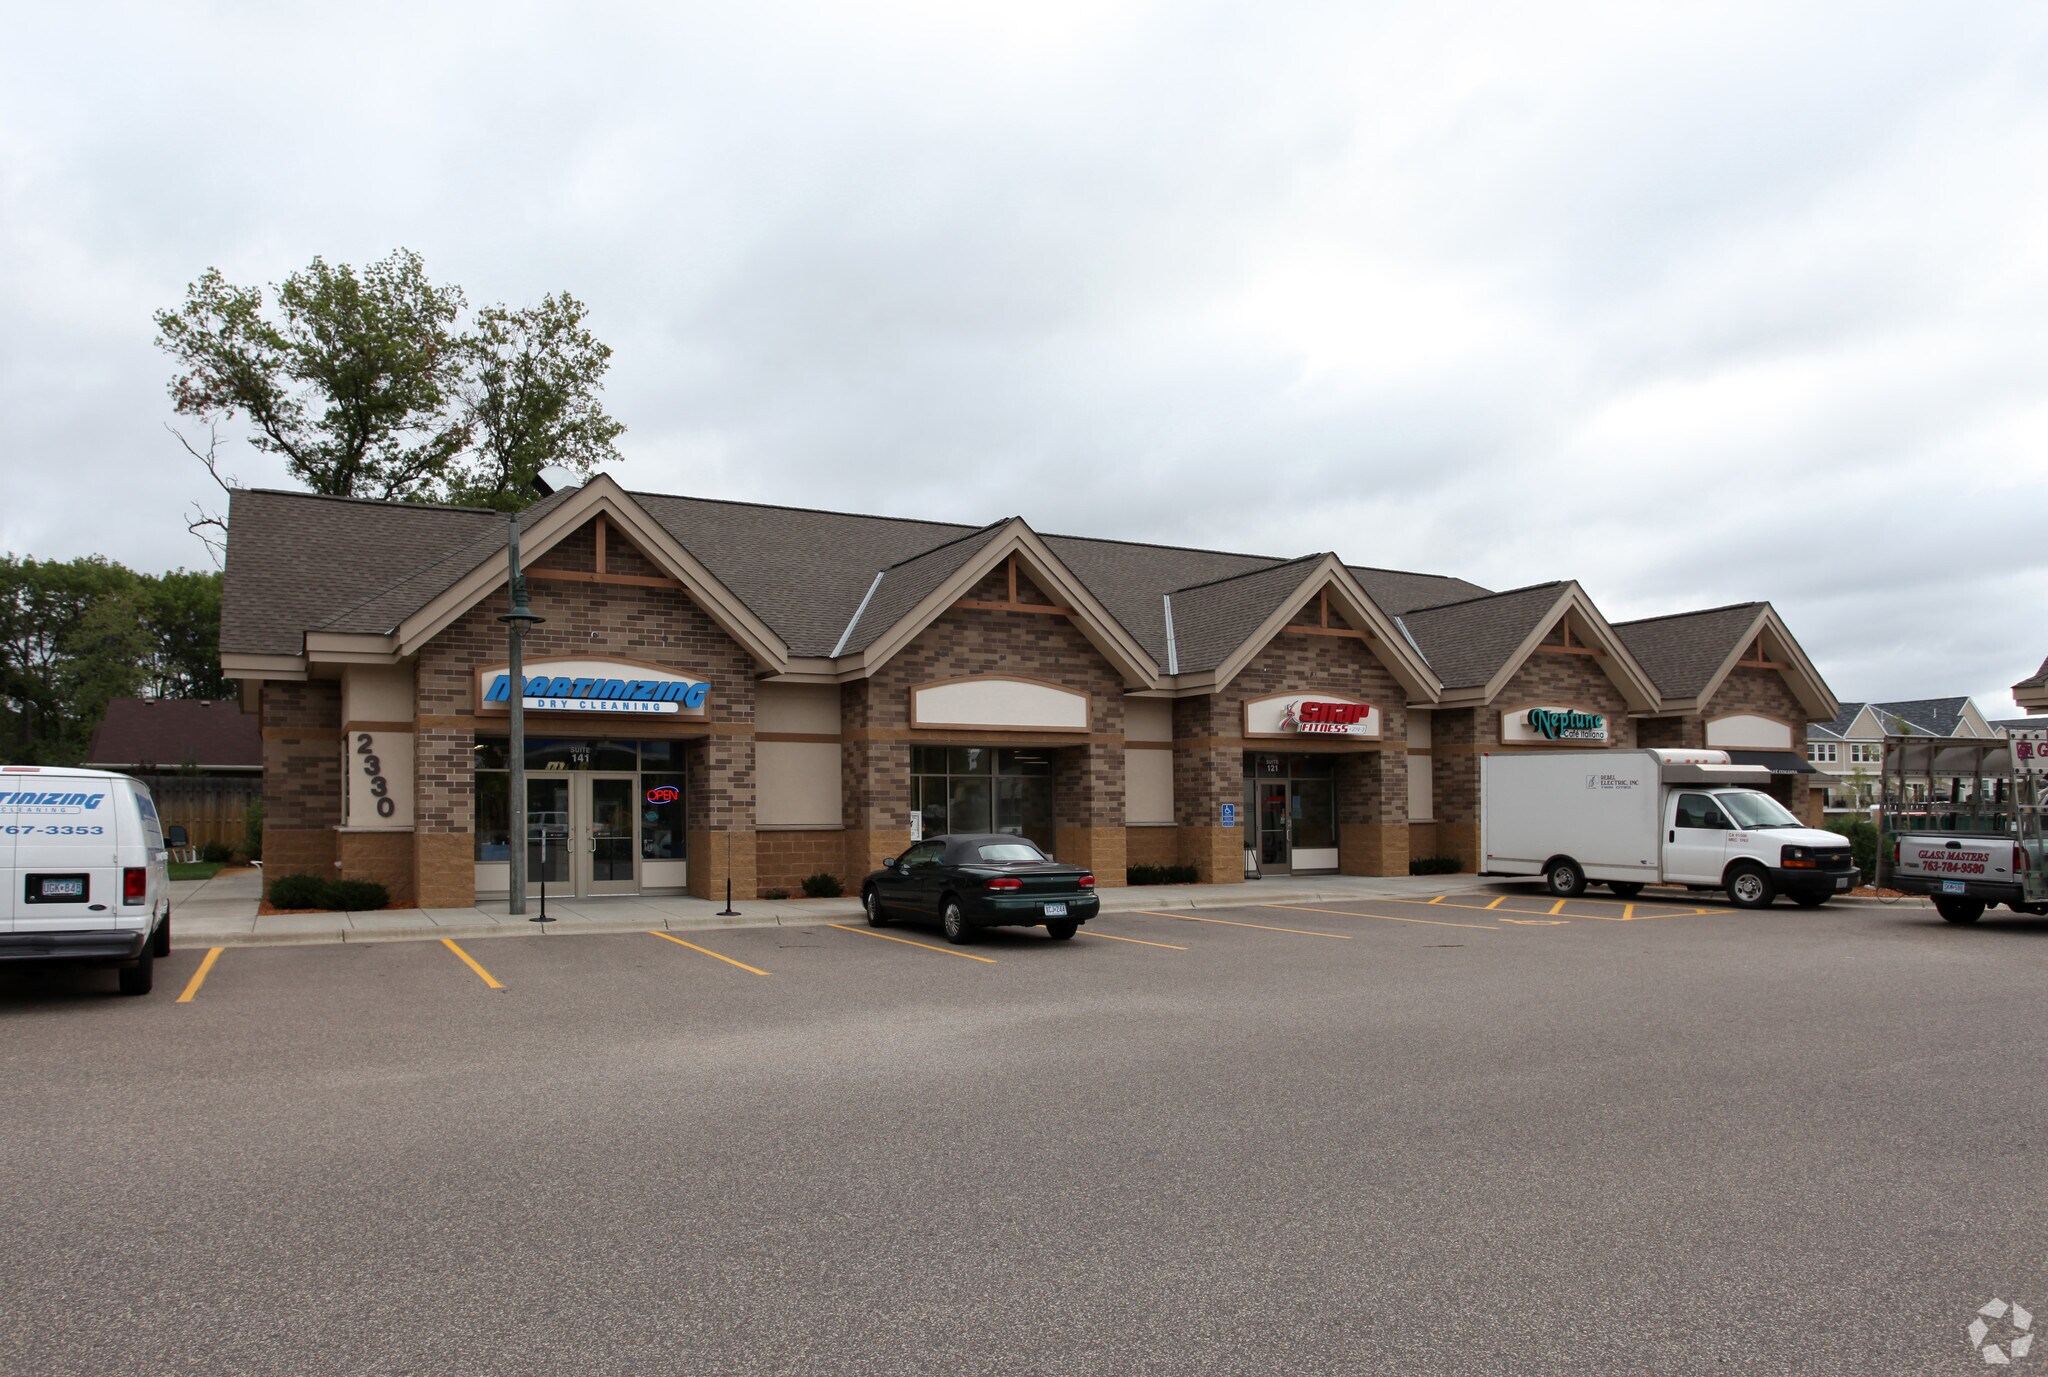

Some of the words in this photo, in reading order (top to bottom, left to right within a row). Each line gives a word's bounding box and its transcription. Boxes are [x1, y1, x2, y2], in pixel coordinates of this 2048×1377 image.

[484, 675, 711, 708] MARTINIZING
[537, 699, 568, 708] DRY
[579, 699, 660, 711] CLEANING
[1531, 708, 1602, 739] Neptune
[571, 753, 589, 762] 141
[357, 733, 394, 817] 2330
[646, 790, 678, 800] OPEN
[1918, 850, 1945, 859] GLASS
[1946, 850, 1989, 862] MASTERS
[1922, 861, 1985, 874] 763-784-9580
